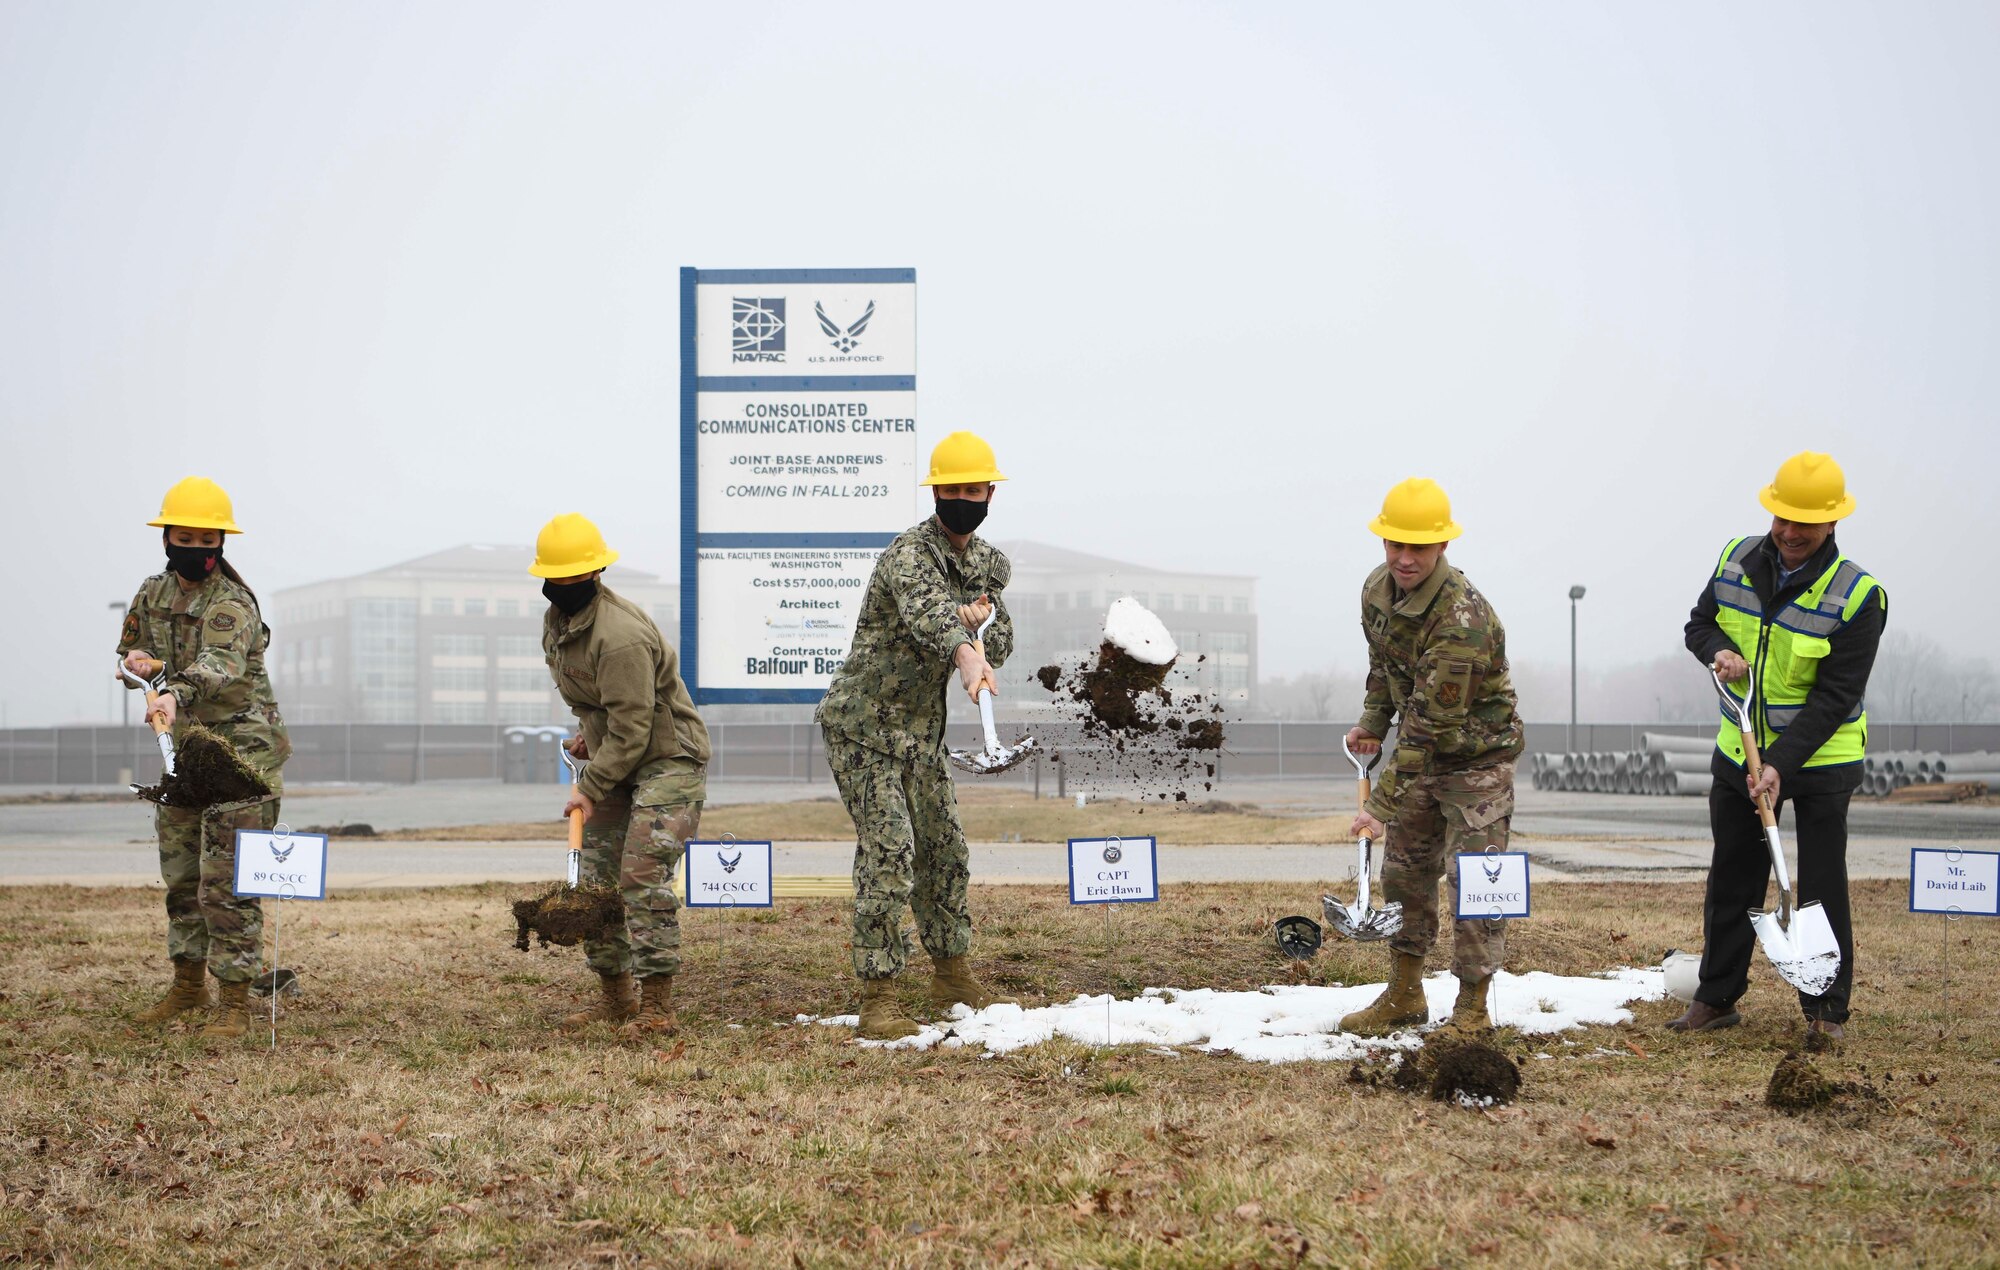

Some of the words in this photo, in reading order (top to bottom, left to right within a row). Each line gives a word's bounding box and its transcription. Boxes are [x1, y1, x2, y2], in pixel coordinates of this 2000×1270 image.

[733, 352, 786, 363] NAVFAC
[828, 355, 846, 363] AIR
[848, 355, 882, 363] FORCE
[745, 403, 868, 417] CONSOLIDATED
[700, 419, 846, 434] COMMUNICATIONS
[851, 418, 915, 433] CENTER
[730, 455, 771, 465] JOINT
[776, 455, 811, 465] BASE
[816, 455, 883, 465] ANDREWS
[753, 466, 784, 475] CAMP
[788, 466, 838, 475] SPRINGS,
[843, 466, 859, 475] MD
[726, 485, 787, 497] COMING
[792, 485, 807, 497] IN
[812, 485, 850, 497] FALL
[854, 485, 888, 497] 2023
[753, 578, 782, 587] Cost
[784, 578, 861, 589] $57,000,000
[780, 599, 841, 609] Architect
[773, 646, 843, 656] Contractor
[747, 657, 809, 675] Balfour
[1097, 871, 1130, 881] CAPT
[1947, 867, 1966, 877] Mr.
[253, 872, 267, 881] 89
[269, 873, 307, 884] CS/CC
[702, 882, 720, 891] 744
[722, 882, 758, 892] CS/CC
[1087, 886, 1108, 896] Eric
[1112, 885, 1142, 894] Hawn
[1926, 880, 1958, 890] David
[1962, 882, 1986, 892] Laib
[1466, 894, 1482, 903] 316
[1484, 893, 1521, 903] CES/CC
